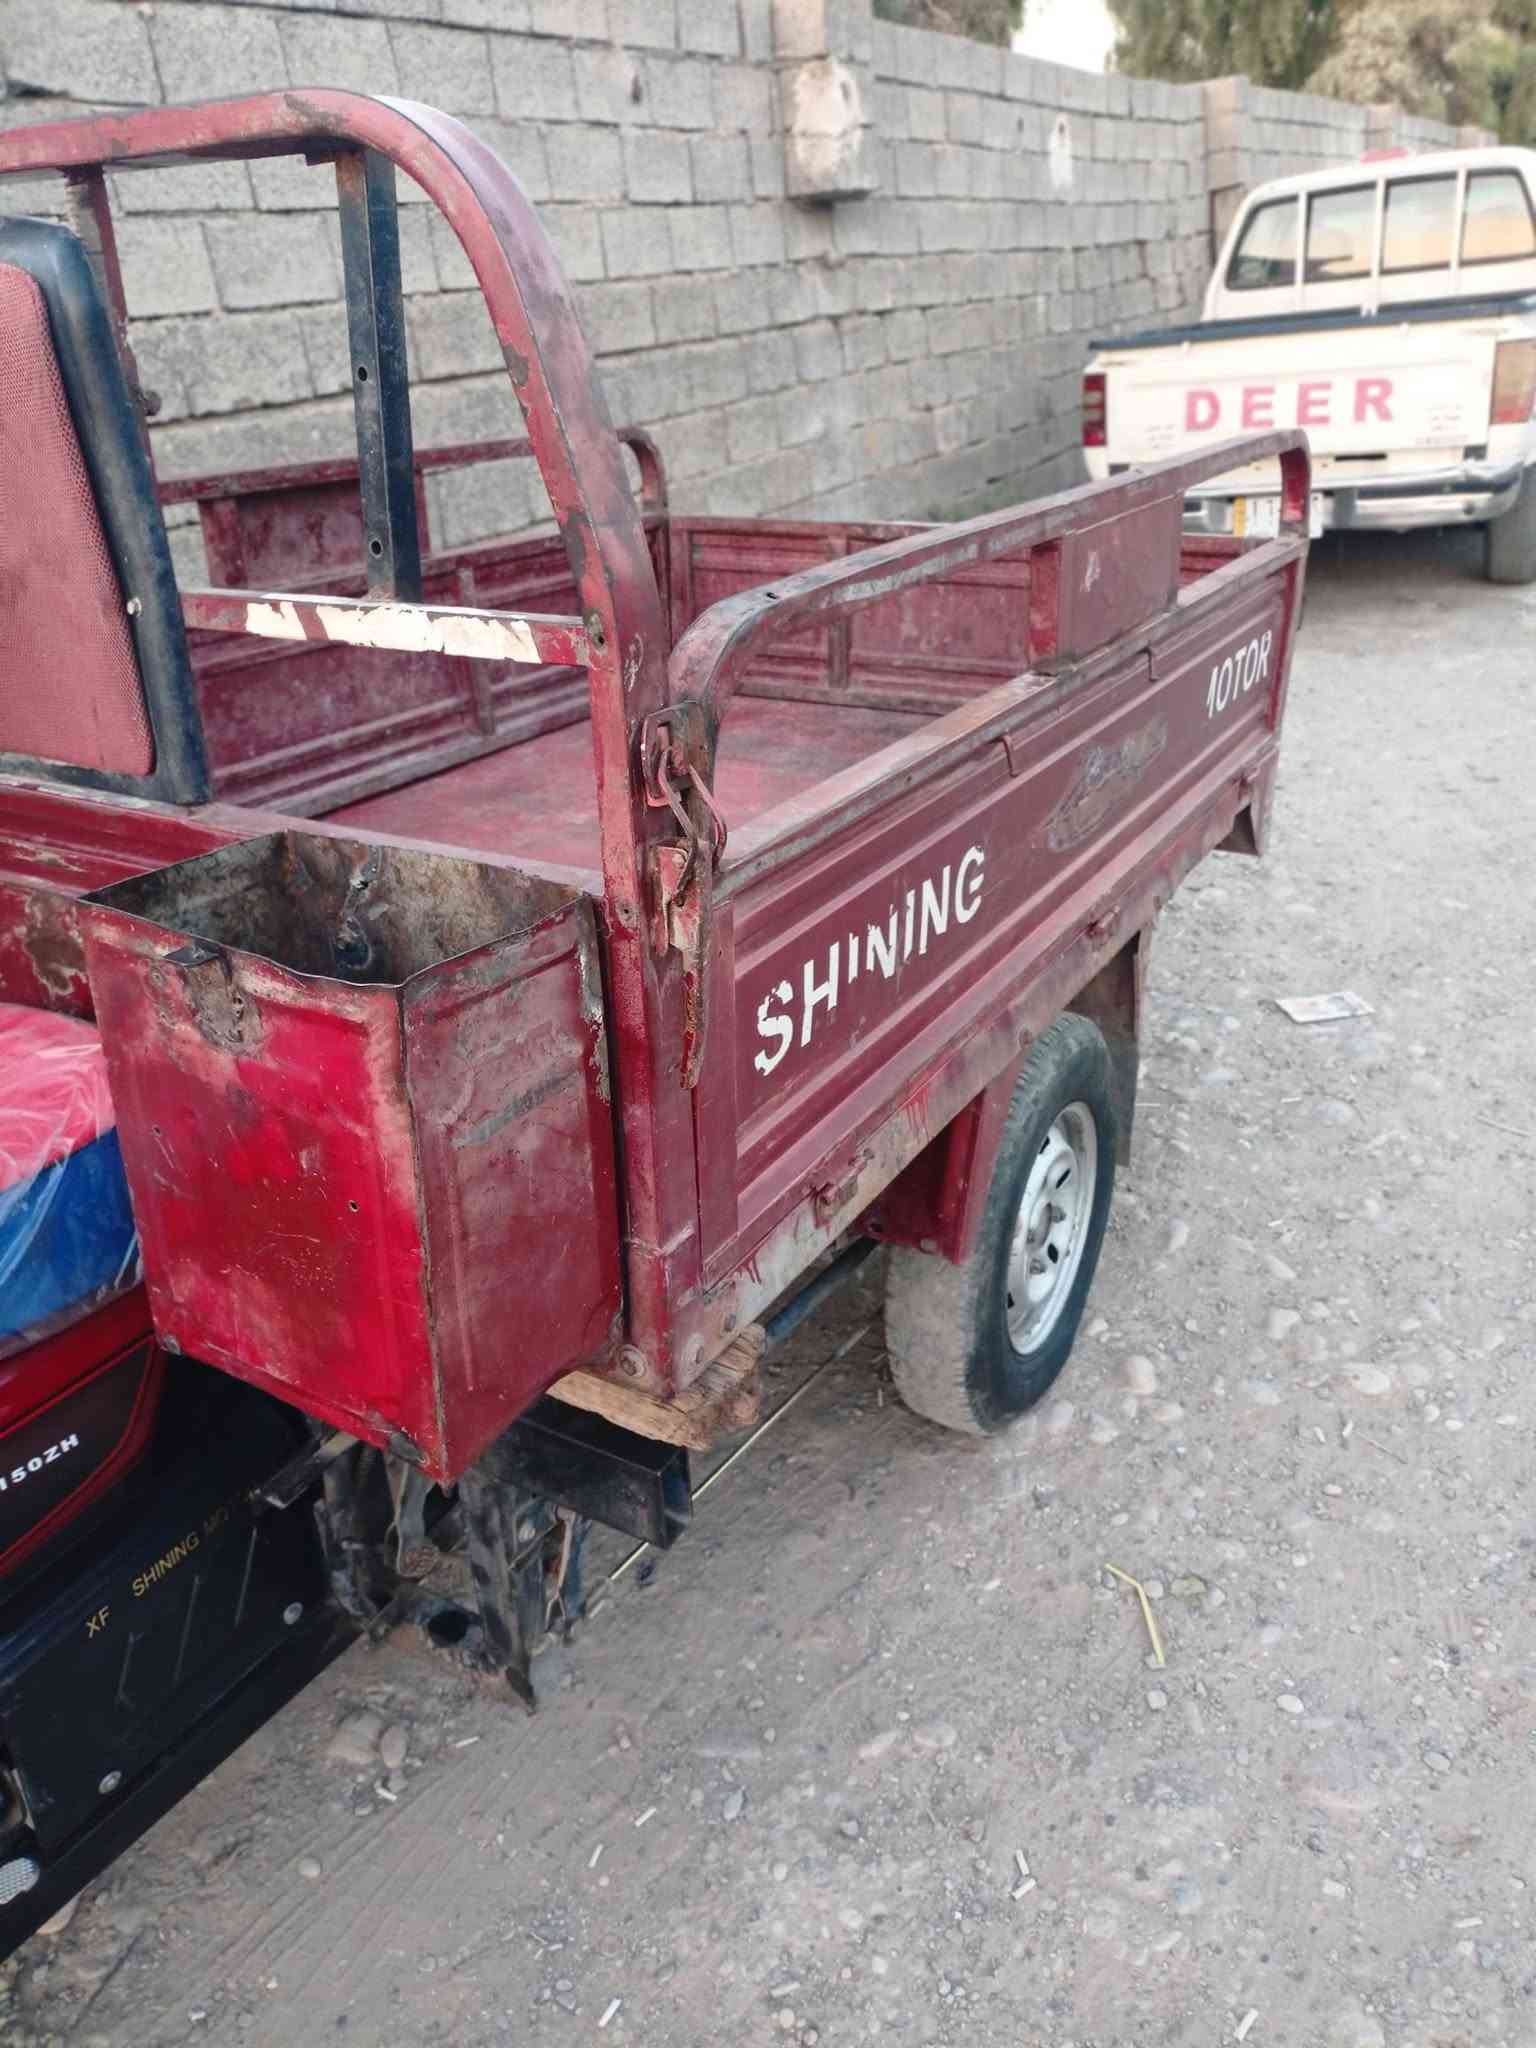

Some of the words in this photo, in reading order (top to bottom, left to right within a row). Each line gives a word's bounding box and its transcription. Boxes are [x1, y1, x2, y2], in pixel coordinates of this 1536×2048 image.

[1185, 378, 1395, 432] DEER
[754, 844, 985, 1077] SHINING
[86, 1605, 111, 1638] XF
[132, 1531, 200, 1597] SHINING
